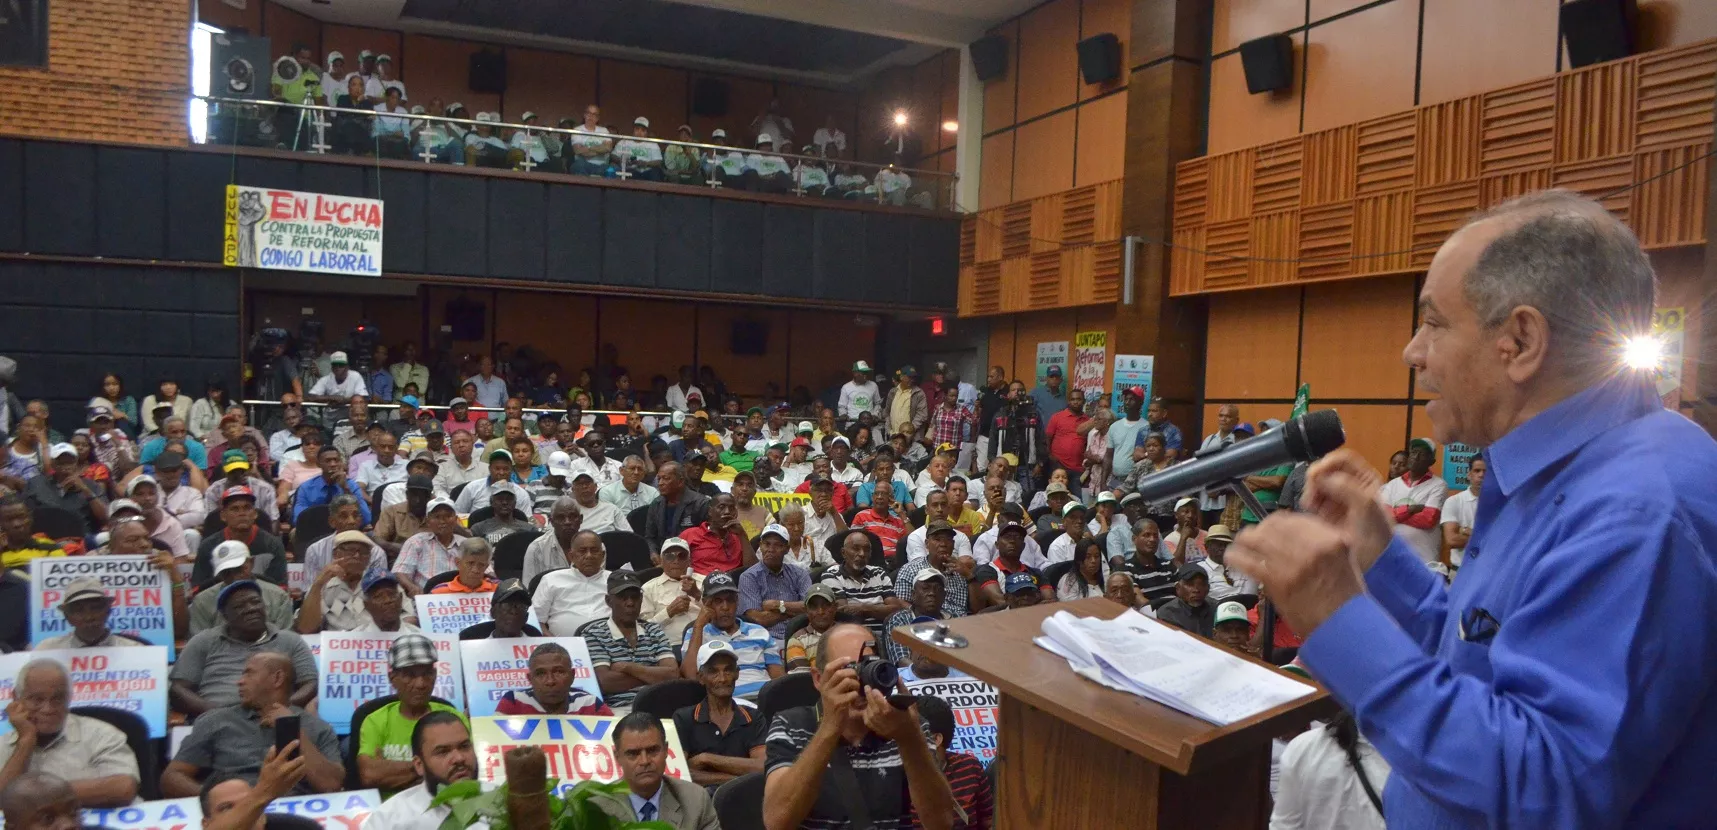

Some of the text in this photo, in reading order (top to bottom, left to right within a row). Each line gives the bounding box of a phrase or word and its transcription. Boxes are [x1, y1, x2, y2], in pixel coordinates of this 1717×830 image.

[267, 190, 382, 228] EN LUCHA
[226, 189, 237, 262] JUNTAPO
[260, 221, 380, 242] CONTRA LA PROPUESTA
[269, 235, 368, 252] DE REFORMA AL
[260, 248, 378, 273] CODIGO LABORAL
[45, 575, 158, 588] CORDOM
[126, 607, 165, 617] PARA
[431, 614, 484, 623] PAGUE
[71, 655, 109, 671] NO
[478, 660, 511, 671] MAS
[326, 674, 345, 684] EL
[350, 674, 386, 684] DINE
[326, 685, 352, 699] MI
[909, 683, 994, 696] COPROVI
[493, 719, 612, 740] VIV
